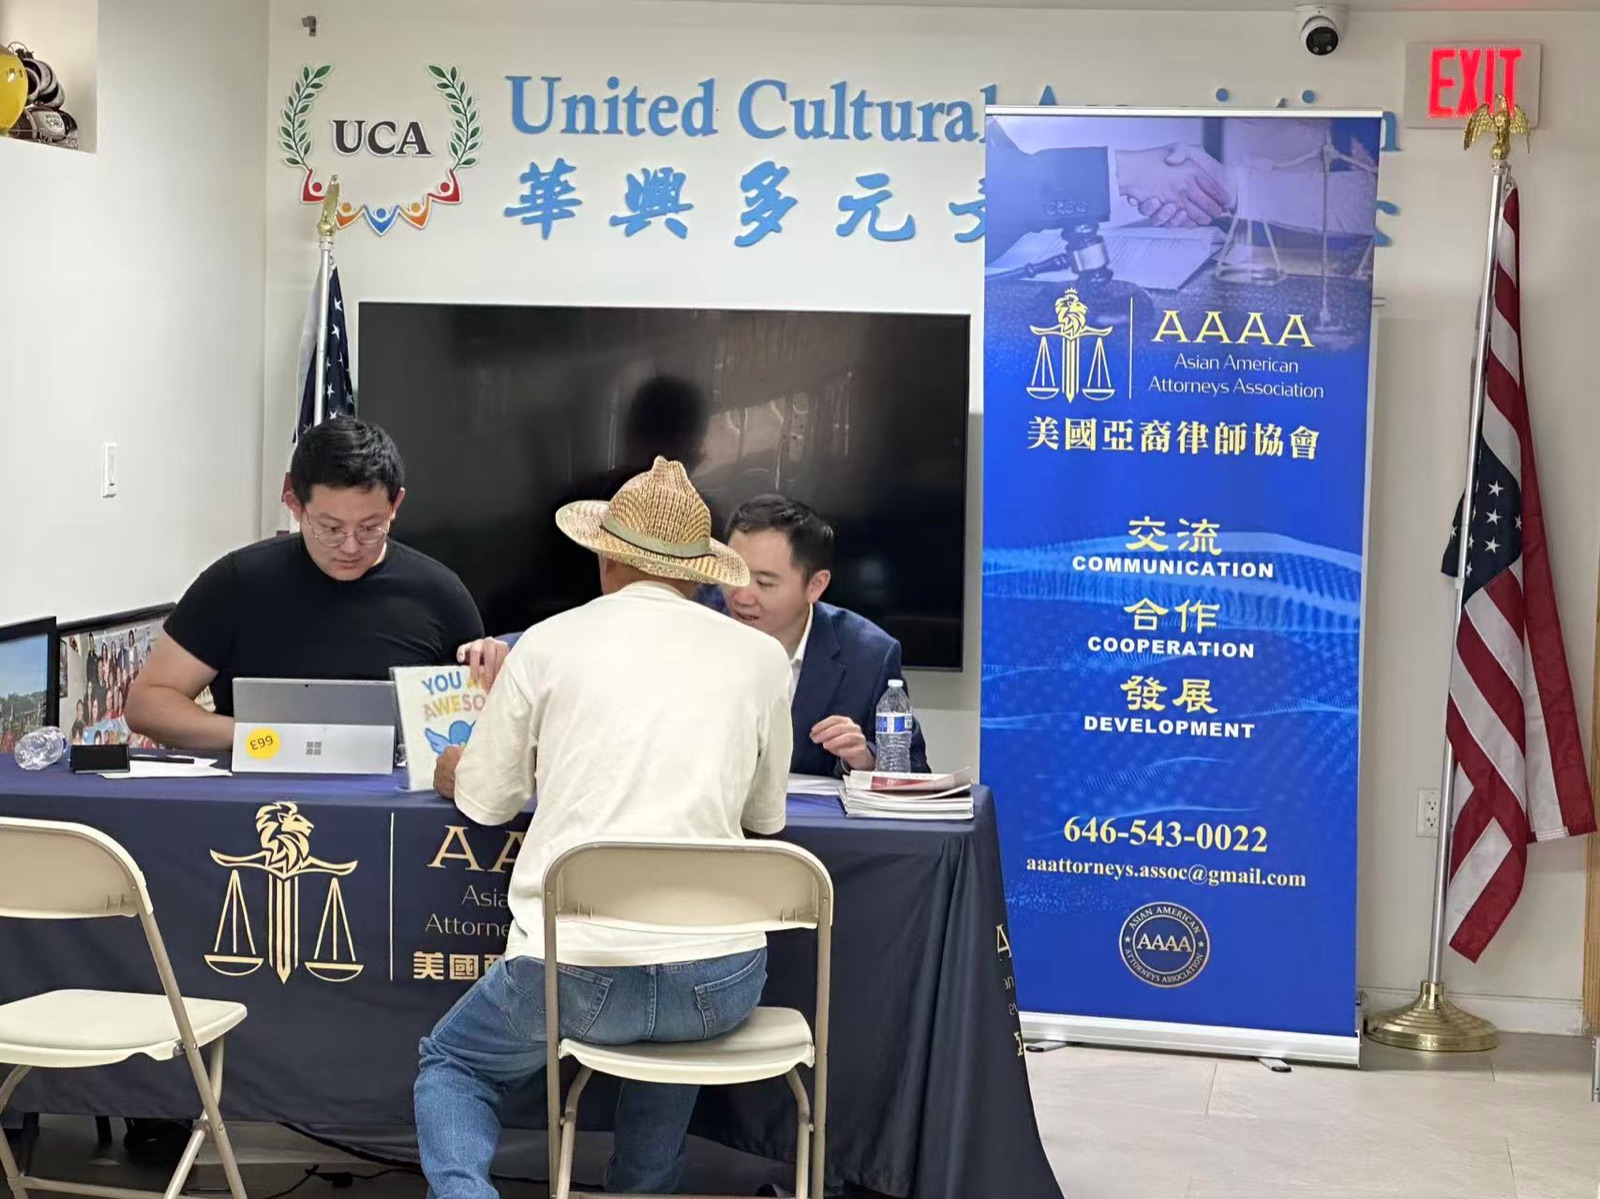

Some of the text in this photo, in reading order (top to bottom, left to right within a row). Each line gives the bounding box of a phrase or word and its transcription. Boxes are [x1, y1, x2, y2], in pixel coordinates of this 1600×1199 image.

[1427, 47, 1523, 119] EXIT
[505, 76, 718, 137] United
[332, 119, 432, 156] UCA
[1151, 309, 1315, 347] AAAA
[1174, 353, 1299, 374] Asian American
[1148, 375, 1324, 399] Attorneys Association
[1027, 416, 1320, 460] 美國亞裔律師協會
[1125, 516, 1222, 555] 交流
[1072, 556, 1274, 578] COMMUNICATION
[1123, 597, 1220, 633] 合作
[1087, 636, 1254, 658] COOPERATION
[421, 670, 462, 695] YOU
[1120, 675, 1218, 714] 發展
[1084, 716, 1255, 738] DEVELOPMENT
[1063, 815, 1268, 853] 646-543-0022
[1026, 857, 1307, 887] aaattorneys.assoc@gmail.com
[1129, 906, 1202, 934] ASIAN AMERICAN
[1136, 932, 1192, 952] AAAA
[1125, 948, 1204, 983] ATTORNEYS ASSOCIATION
